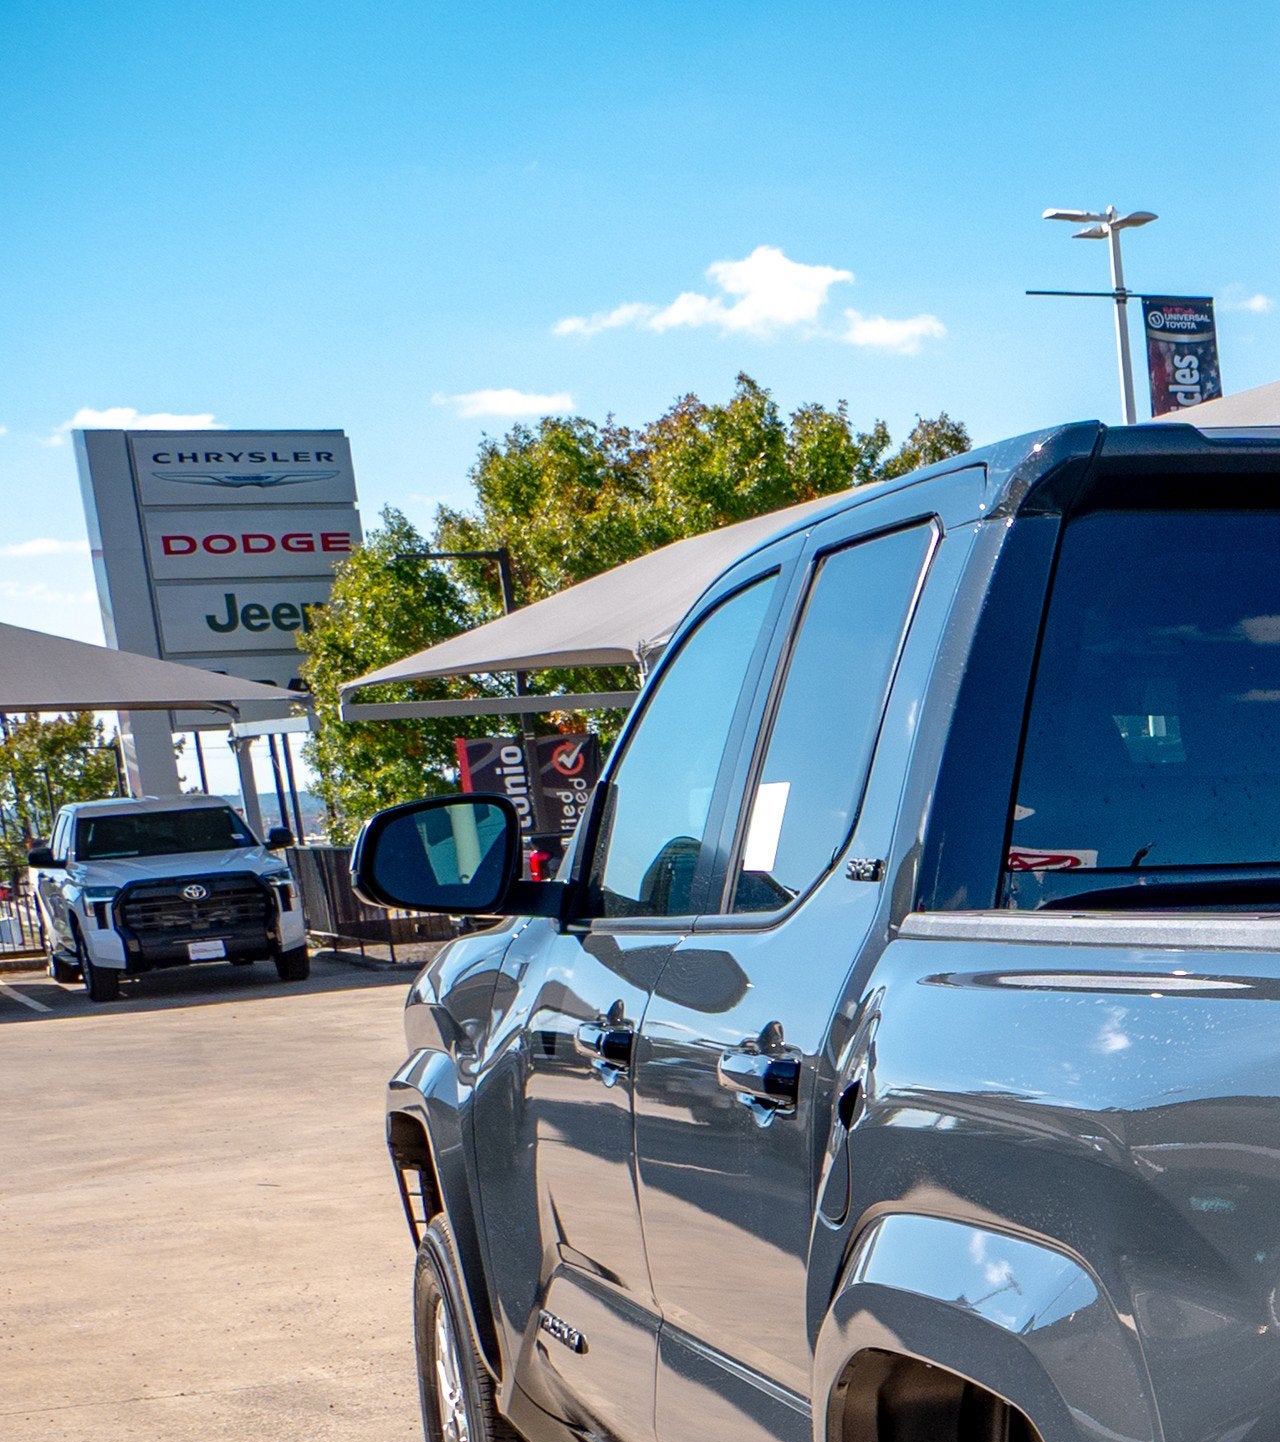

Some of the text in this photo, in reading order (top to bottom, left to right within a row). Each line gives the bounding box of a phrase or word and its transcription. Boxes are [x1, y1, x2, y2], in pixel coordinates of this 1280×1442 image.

[1164, 313, 1211, 322] UNIVERSAL
[1166, 320, 1197, 330] TOYOTA
[1168, 354, 1202, 411] cles
[152, 450, 334, 464] CHRYSLER
[161, 532, 352, 556] DODGE
